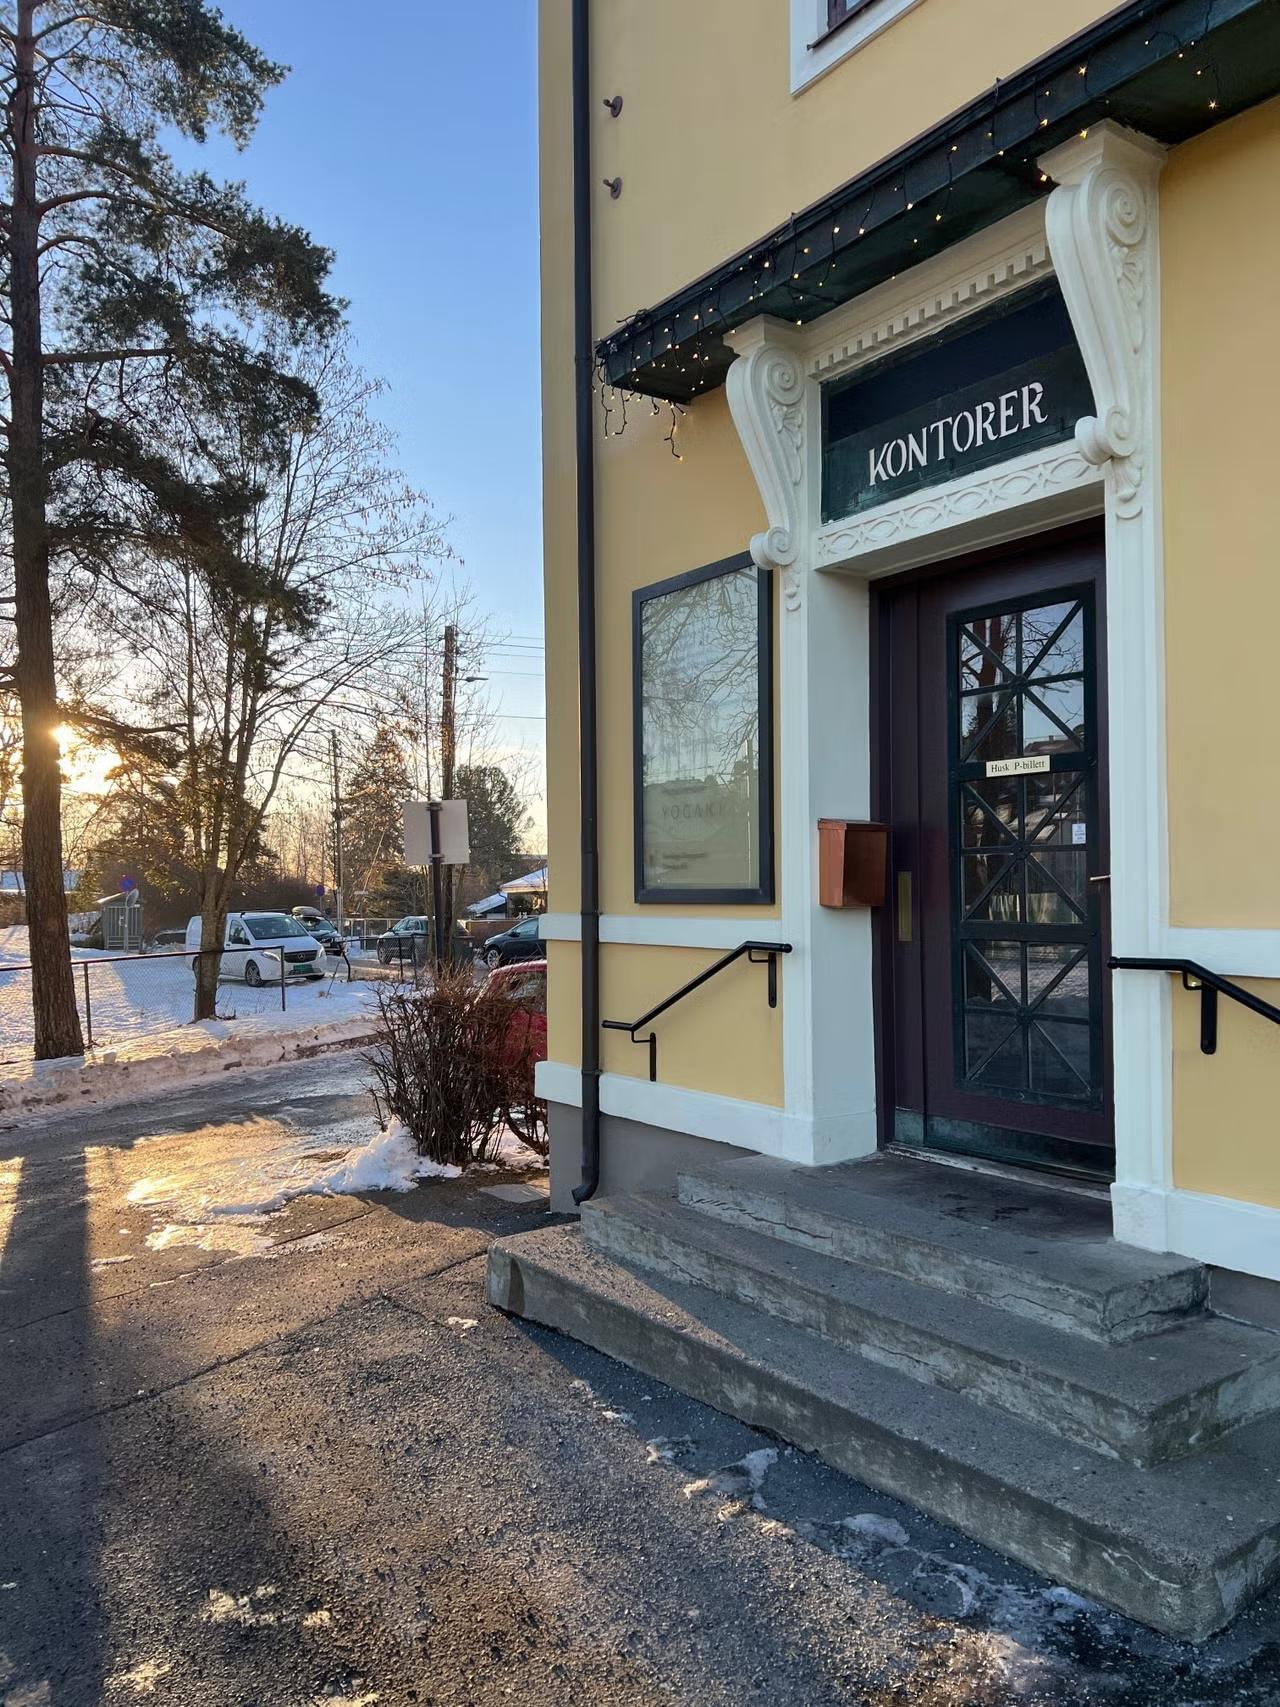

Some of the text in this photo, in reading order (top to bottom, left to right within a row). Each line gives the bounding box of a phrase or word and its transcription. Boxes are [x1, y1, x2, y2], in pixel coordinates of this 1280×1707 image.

[869, 382, 1048, 486] KONTORER
[991, 760, 1045, 773] Husk P-billett
